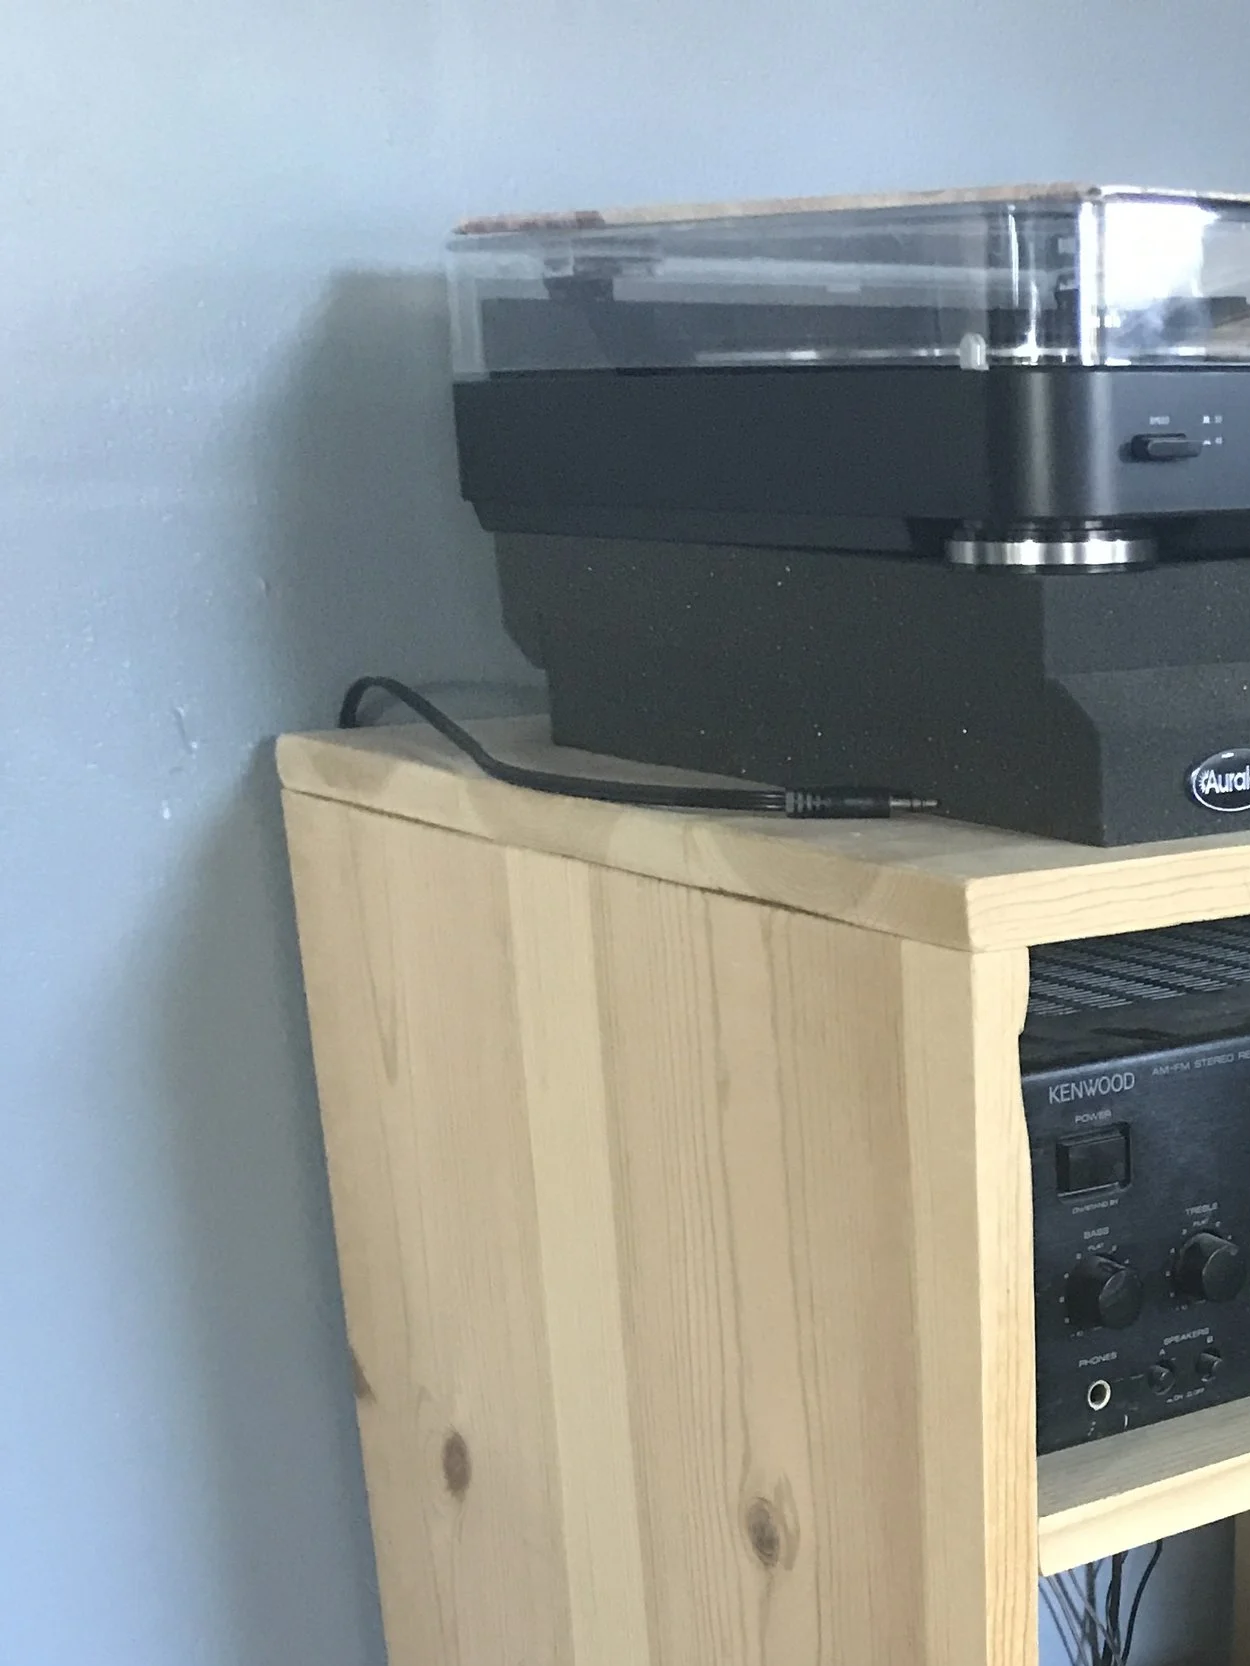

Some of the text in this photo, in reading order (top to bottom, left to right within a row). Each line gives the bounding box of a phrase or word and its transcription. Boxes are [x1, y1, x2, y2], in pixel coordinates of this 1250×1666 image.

[1194, 1054, 1235, 1069] STEREO
[1048, 1071, 1136, 1105] KENWOOD
[1074, 1108, 1113, 1125] POWER
[1082, 1225, 1111, 1241] BASS
[1163, 1326, 1211, 1346] SPEAKERS
[1077, 1350, 1118, 1368] PHONES
